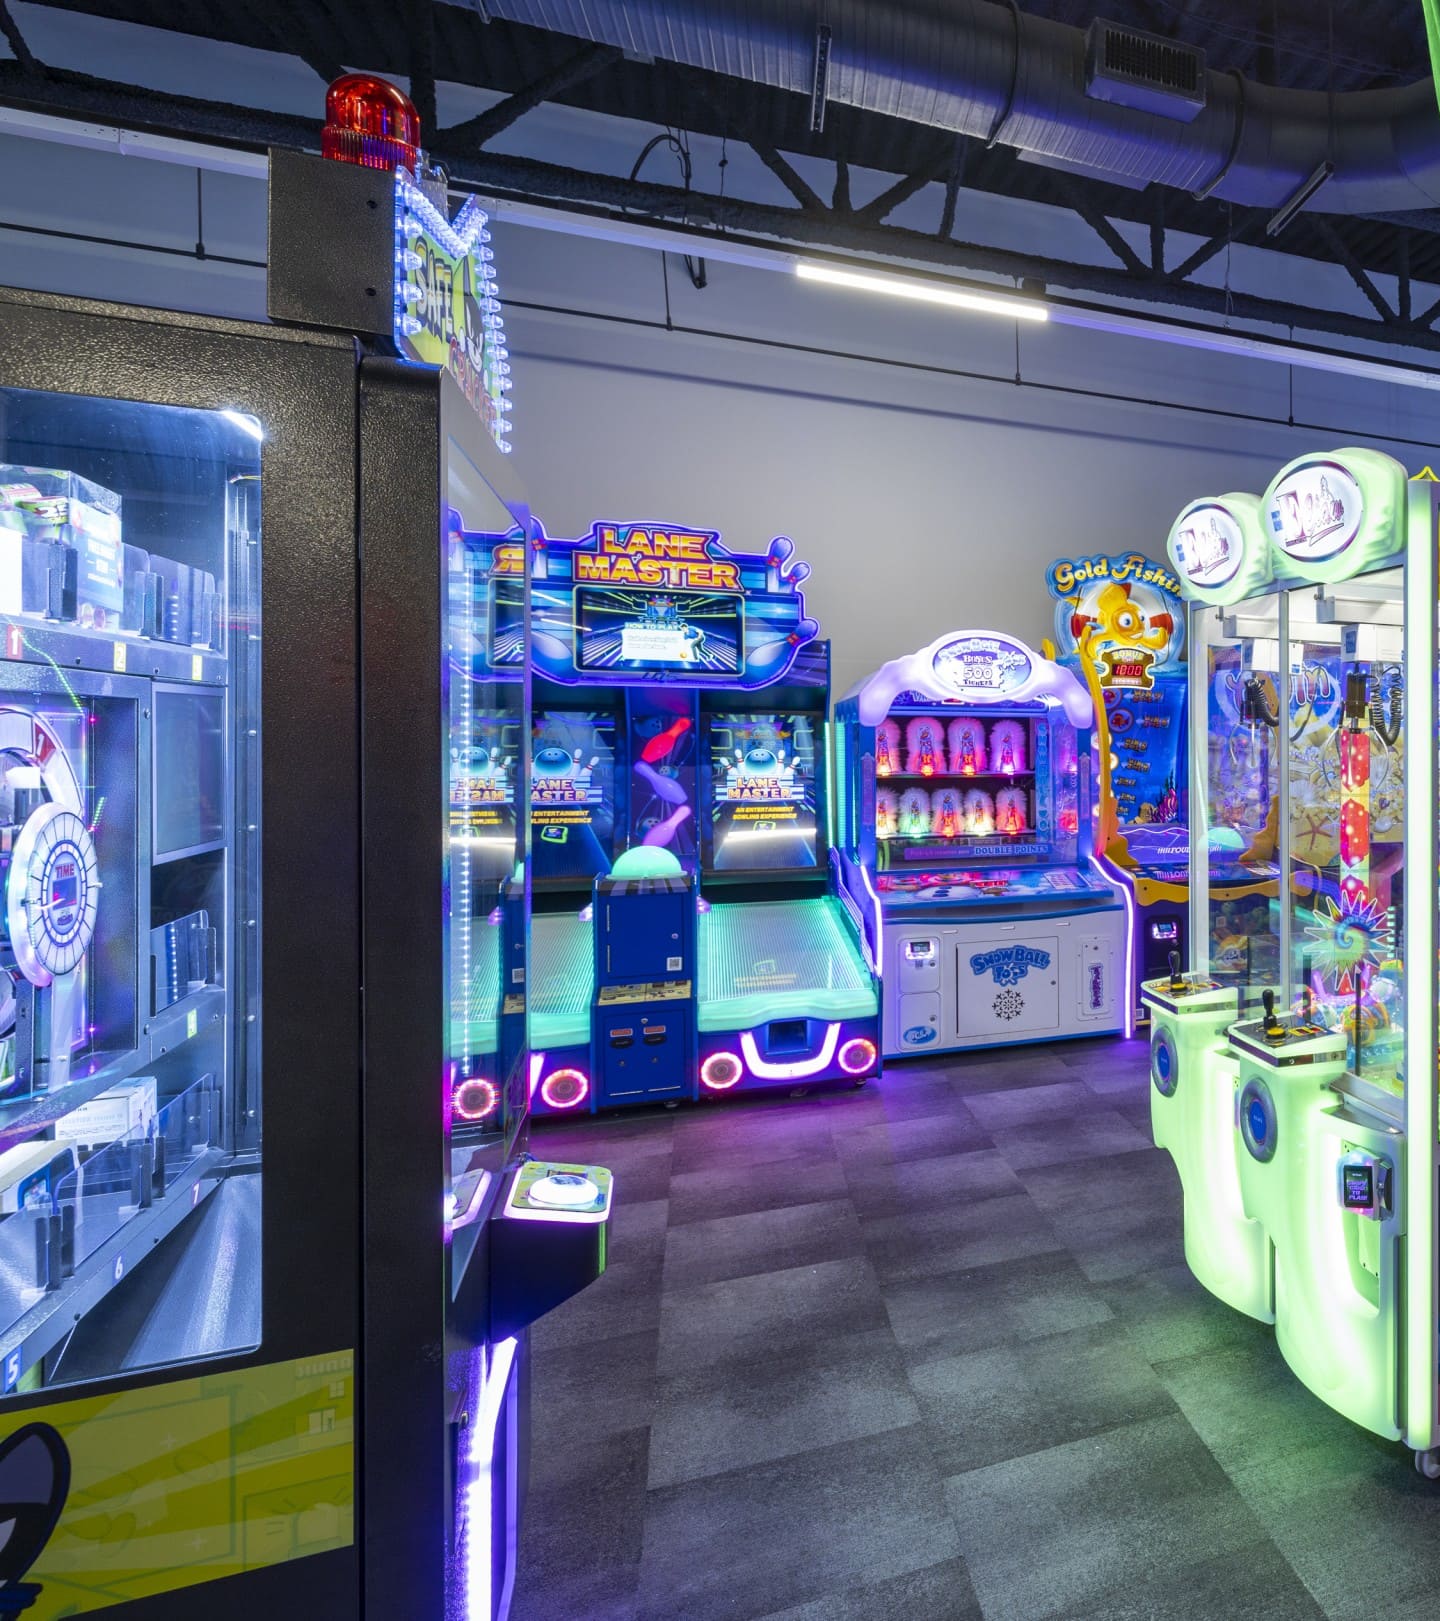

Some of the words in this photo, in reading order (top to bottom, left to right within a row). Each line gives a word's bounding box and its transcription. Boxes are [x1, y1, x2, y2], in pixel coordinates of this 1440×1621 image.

[415, 237, 453, 341] SAFE
[603, 527, 711, 560] LANE
[576, 554, 739, 588] MASTER
[1055, 559, 1108, 593] Gold
[115, 648, 124, 669] 2
[963, 667, 993, 680] 500
[727, 788, 792, 800] MASTER
[736, 777, 778, 789] LANE
[531, 790, 586, 802] ASTER
[975, 846, 1011, 855] DOUBLE
[1014, 845, 1048, 854] POINTS
[55, 864, 75, 878] TIME
[970, 945, 1051, 974] SNOWBALL
[114, 1256, 123, 1279] 6
[8, 1356, 18, 1384] 5
